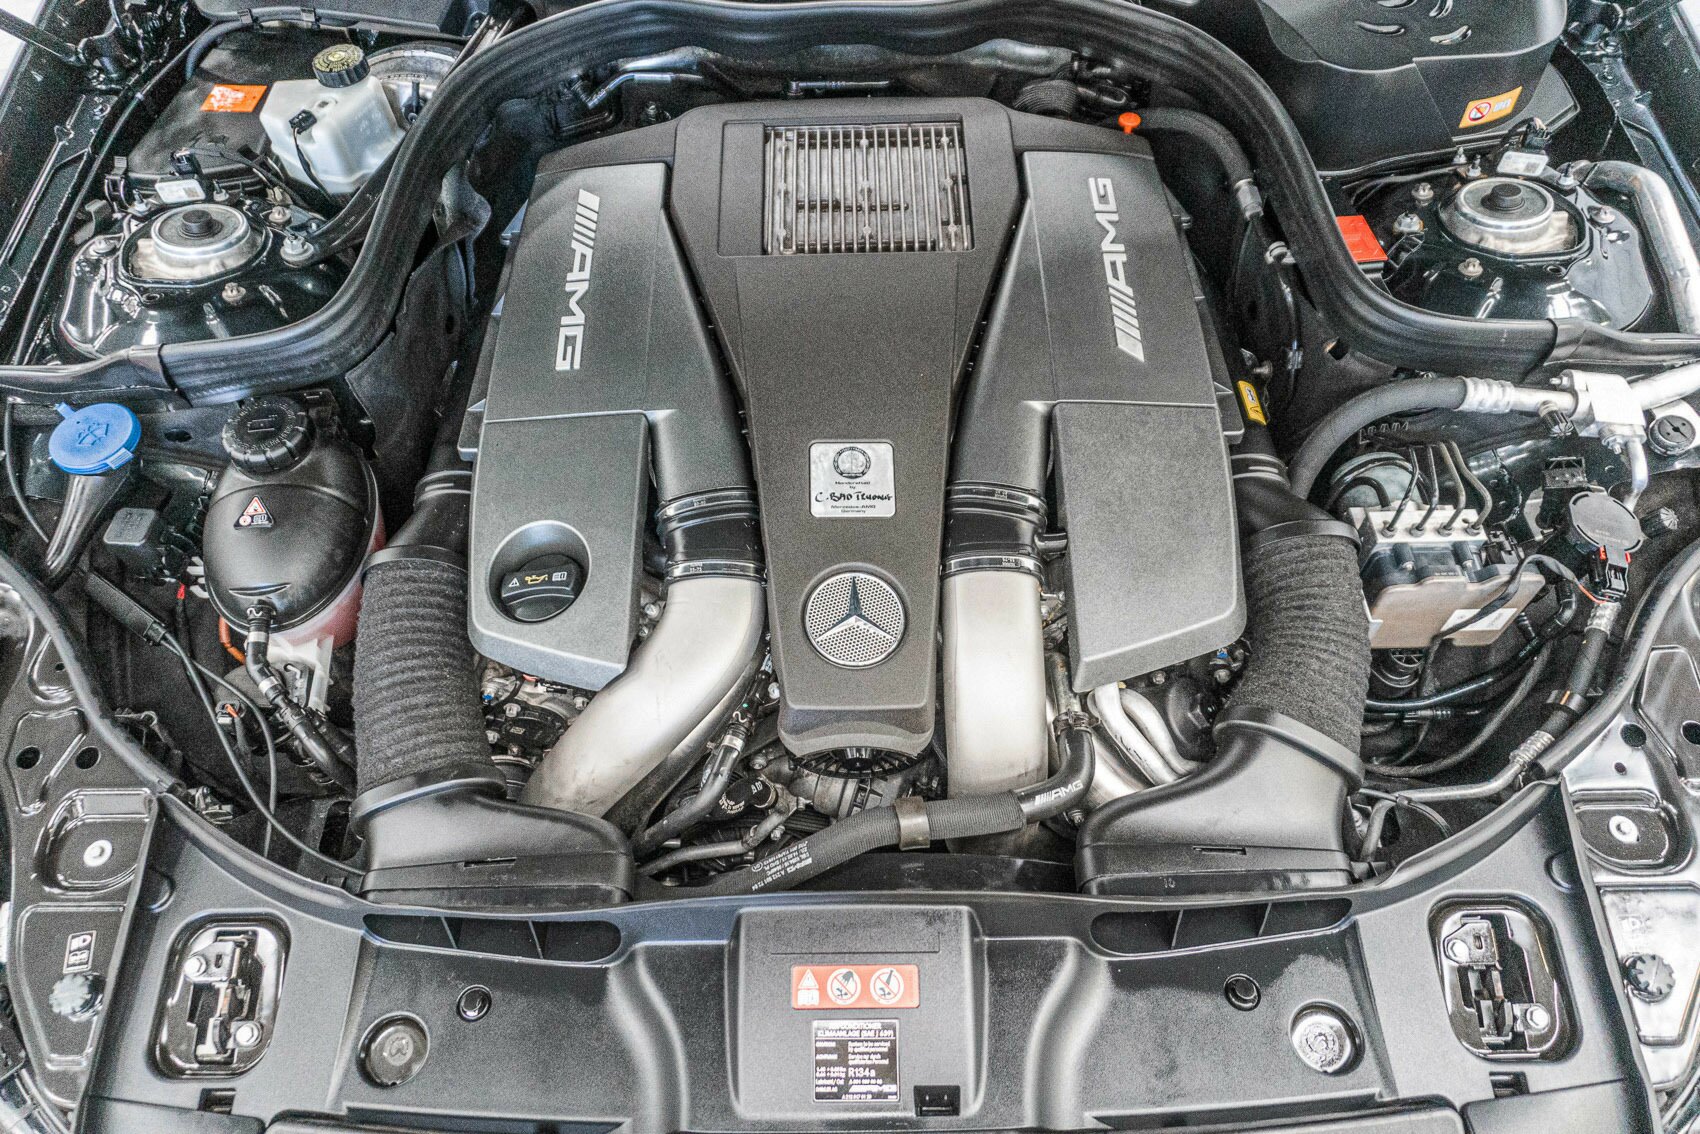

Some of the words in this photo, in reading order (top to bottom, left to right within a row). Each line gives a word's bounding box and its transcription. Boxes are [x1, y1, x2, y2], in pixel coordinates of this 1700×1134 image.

[1088, 177, 1134, 298] AMG
[555, 239, 594, 371] AMG
[1052, 780, 1084, 801] AMG
[848, 1067, 876, 1078] R134a
